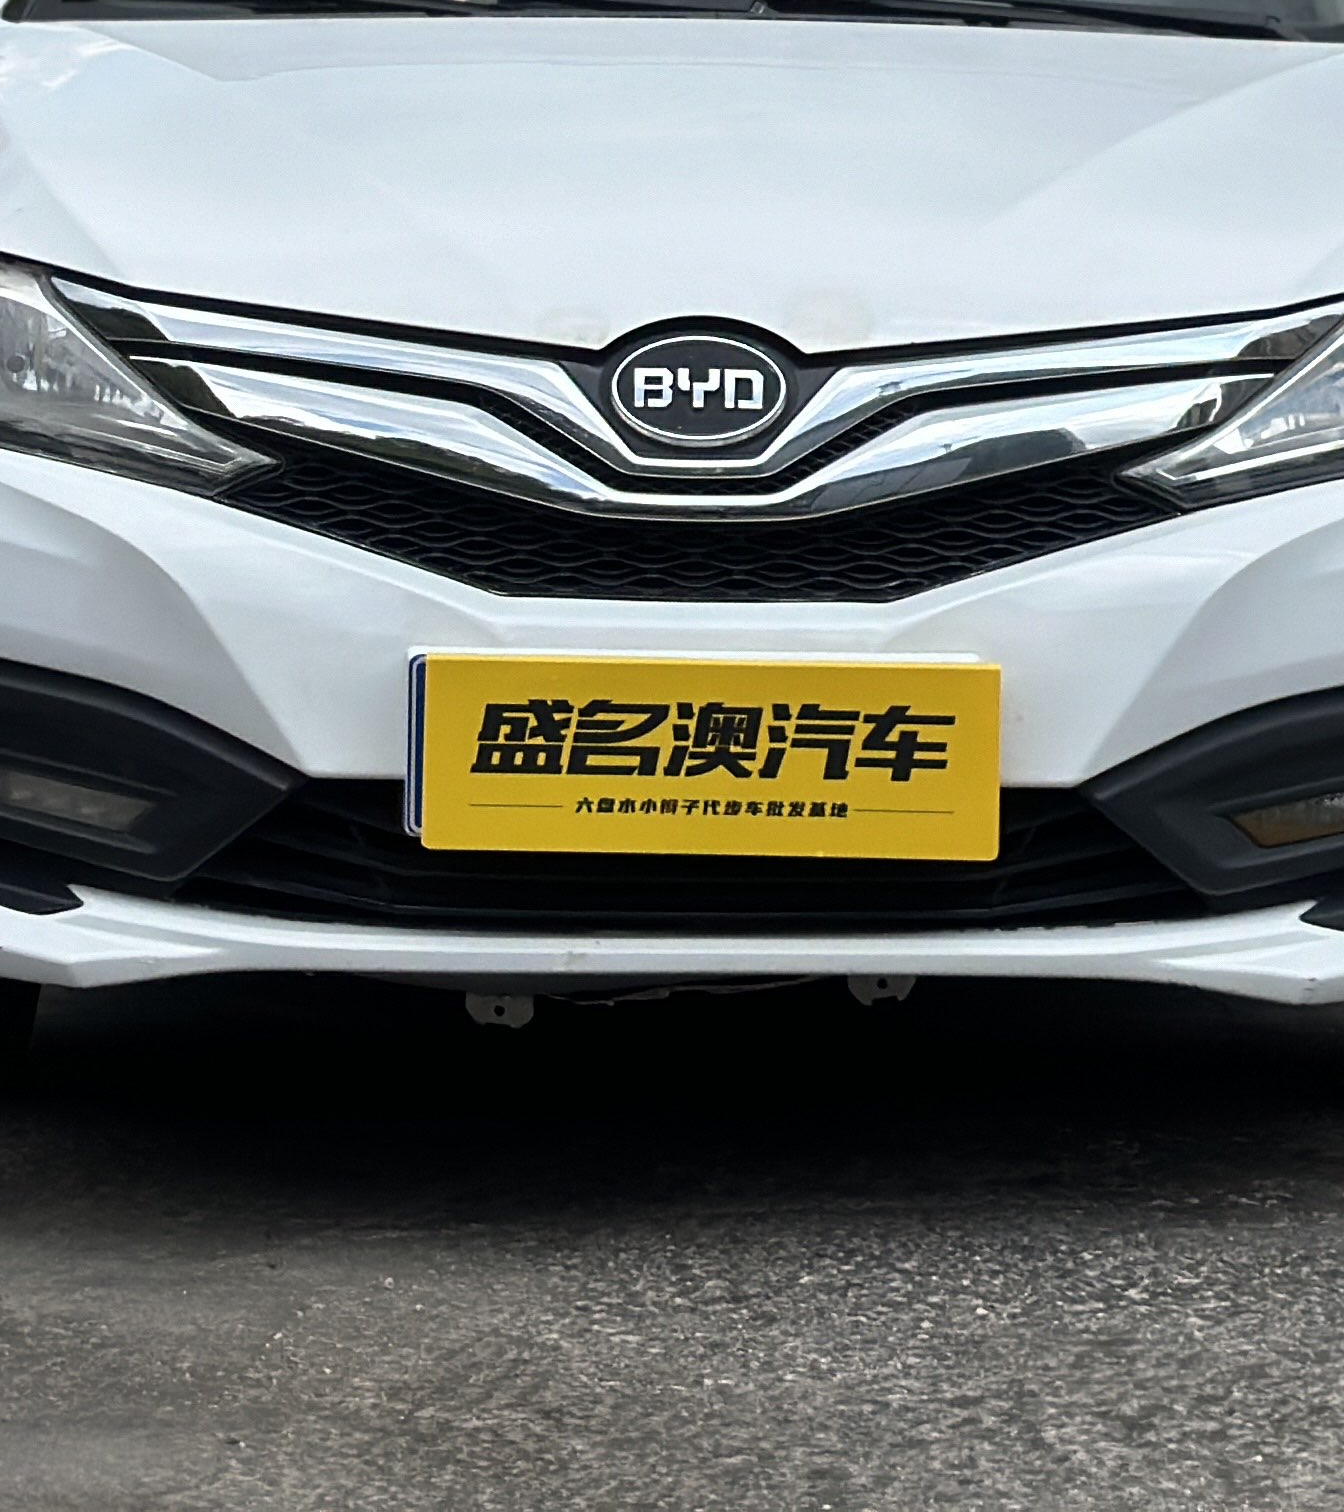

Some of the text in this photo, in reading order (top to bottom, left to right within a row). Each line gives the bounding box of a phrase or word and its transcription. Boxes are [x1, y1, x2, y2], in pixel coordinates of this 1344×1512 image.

[633, 366, 765, 410] BYD
[469, 697, 956, 783] 盛名澳汽车
